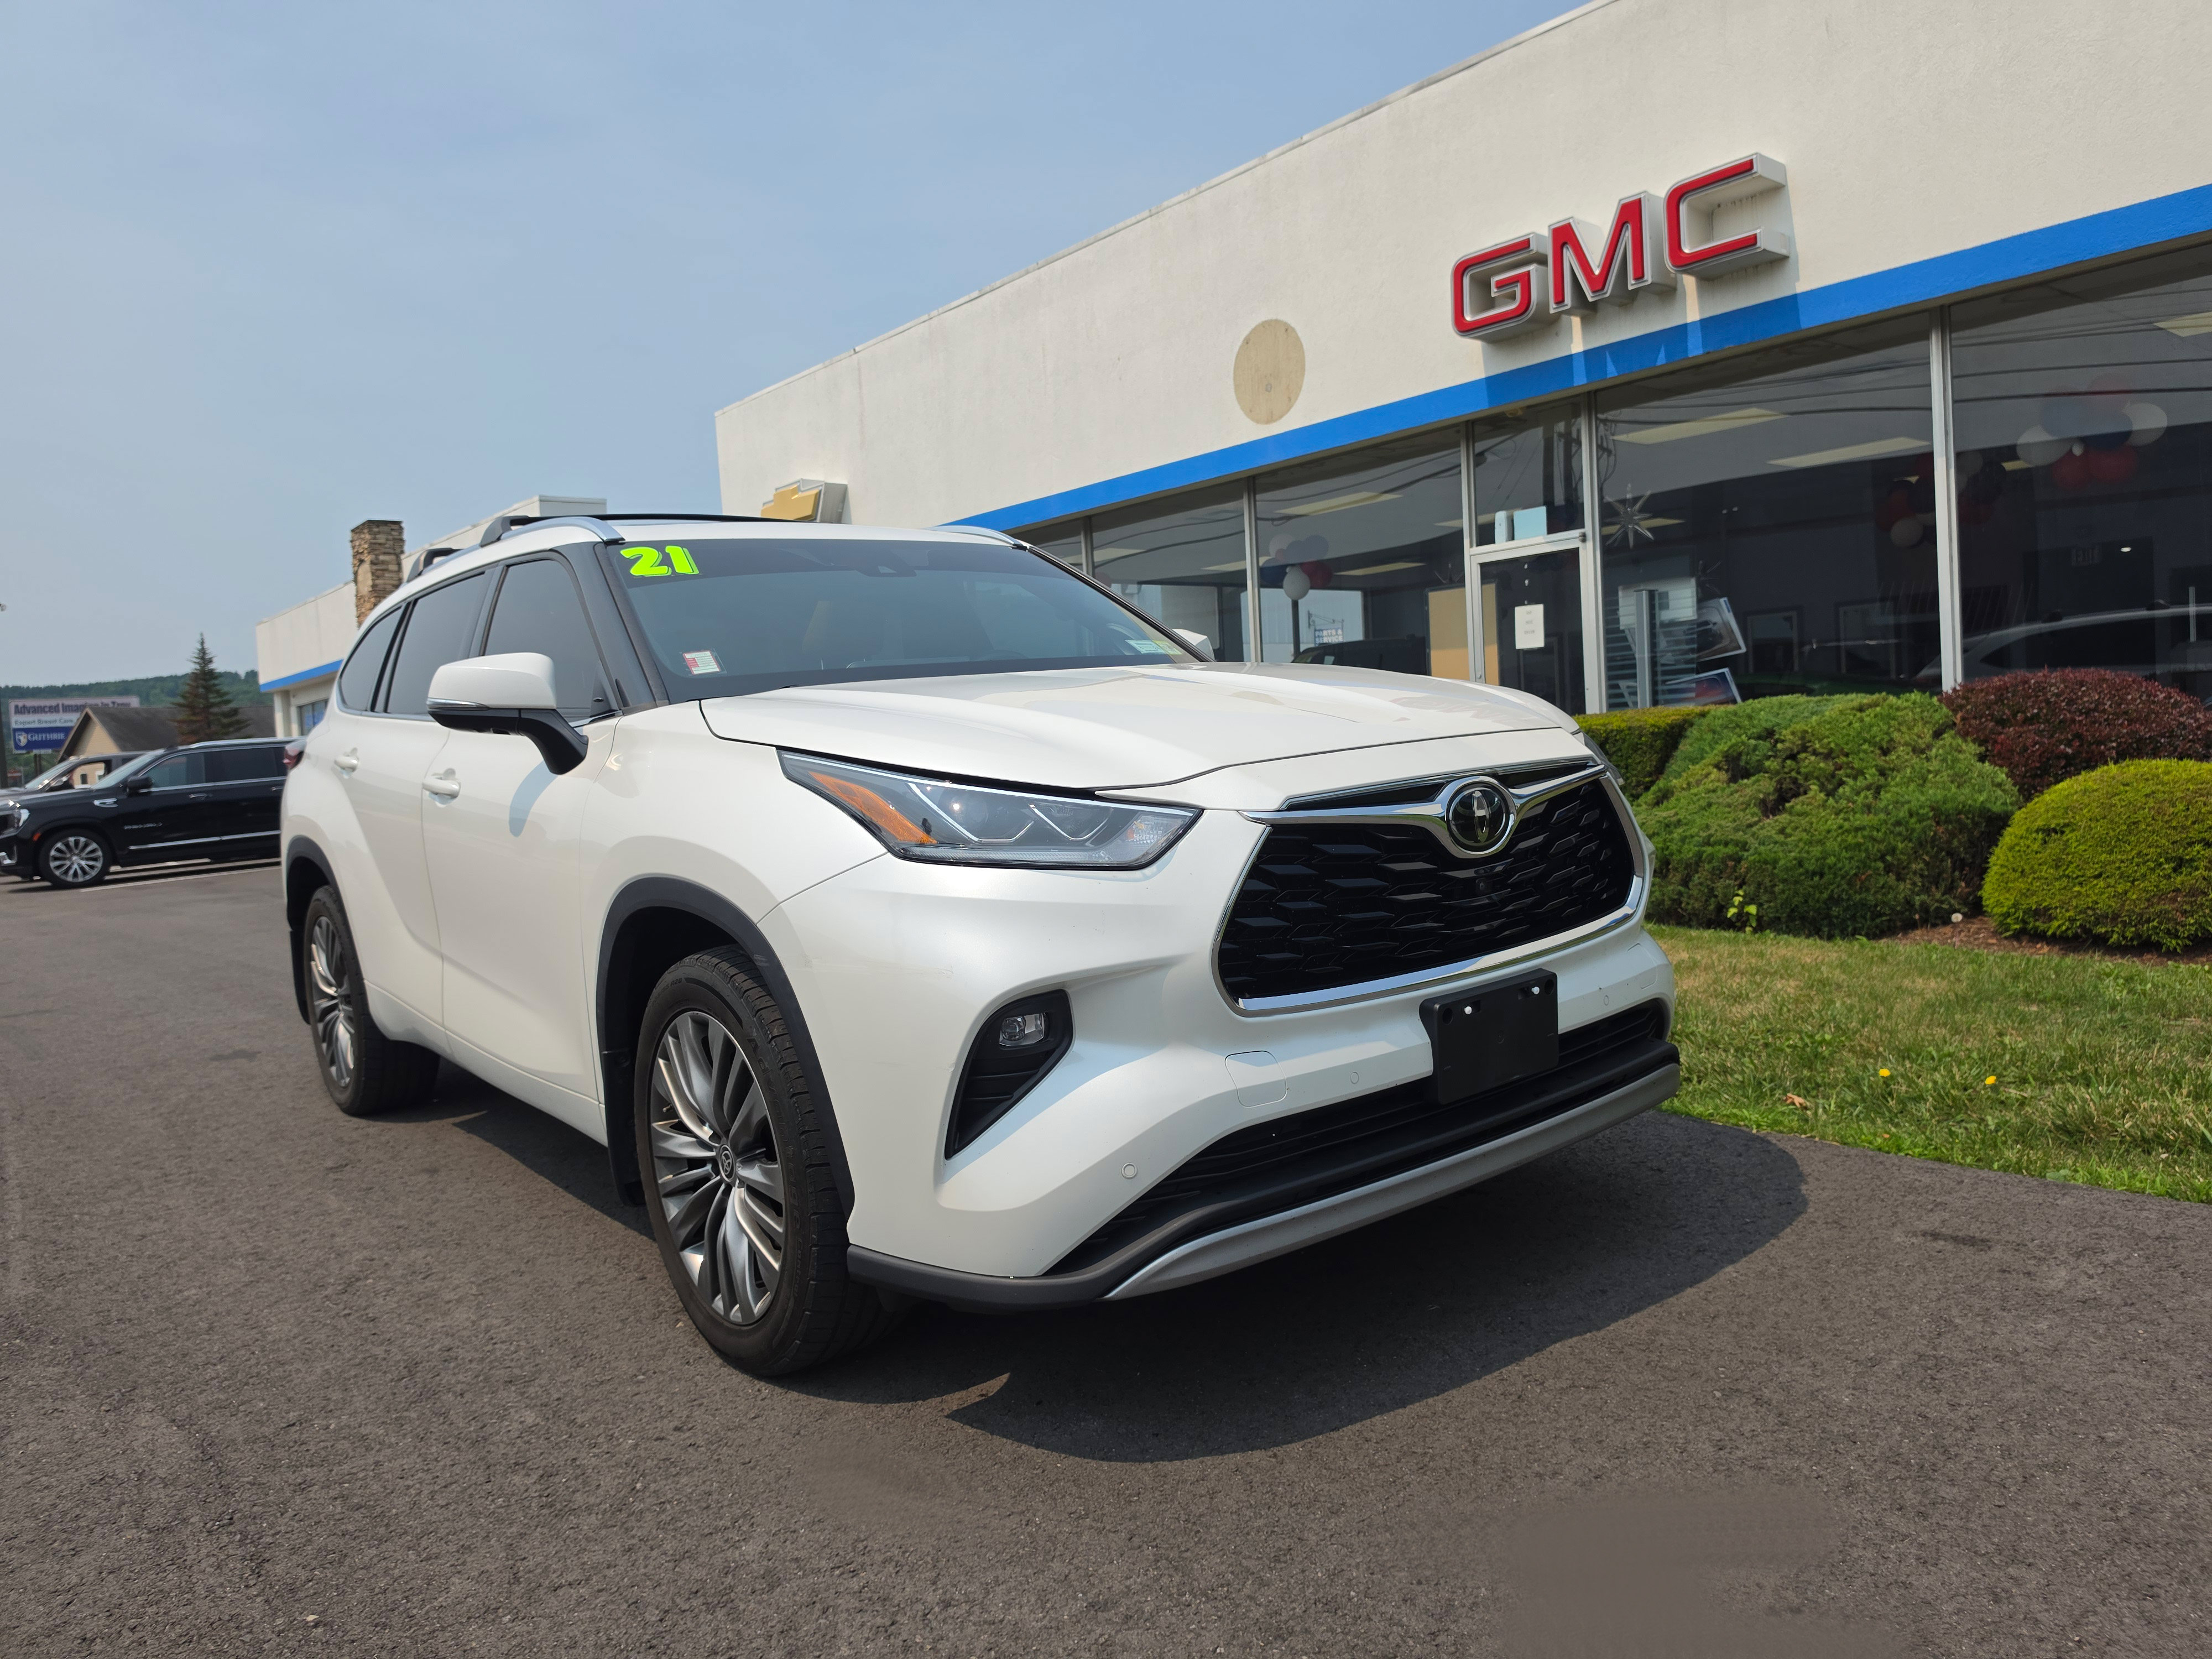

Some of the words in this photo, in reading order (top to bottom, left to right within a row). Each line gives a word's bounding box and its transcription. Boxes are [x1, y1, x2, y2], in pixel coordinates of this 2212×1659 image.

[1451, 152, 1765, 338] GMC
[619, 545, 700, 577] 21
[14, 703, 60, 715] Advanced
[28, 732, 66, 741] GUTHRIE
